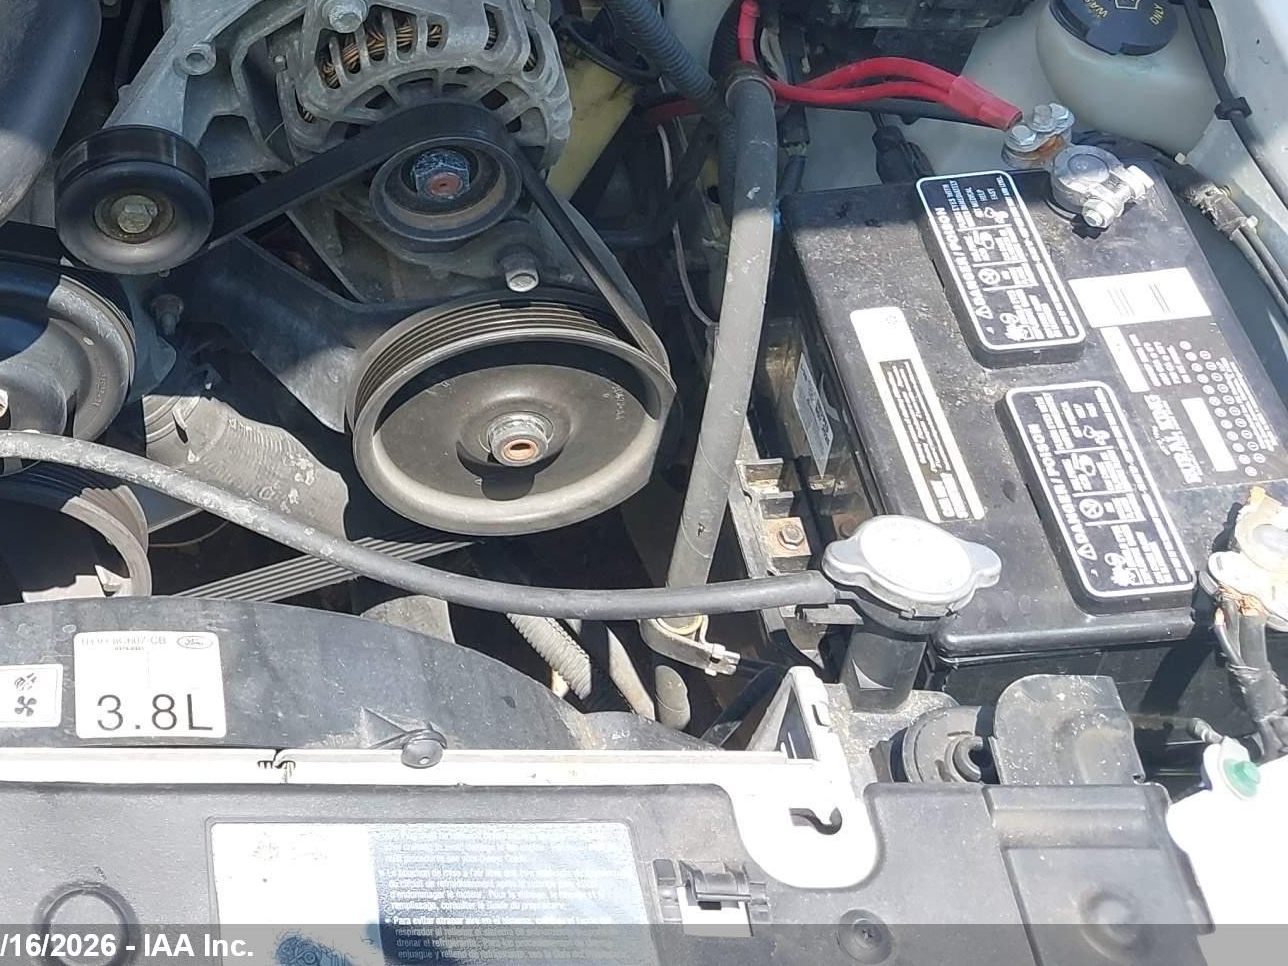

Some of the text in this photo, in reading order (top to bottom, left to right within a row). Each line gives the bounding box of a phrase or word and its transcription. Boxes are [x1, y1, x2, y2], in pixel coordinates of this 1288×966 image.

[1148, 2, 1165, 26] ONLY
[975, 188, 988, 201] HELP
[96, 693, 214, 732] 3.8L
[393, 915, 411, 925] Para
[397, 938, 421, 947] drenar
[398, 949, 433, 960] enjuague
